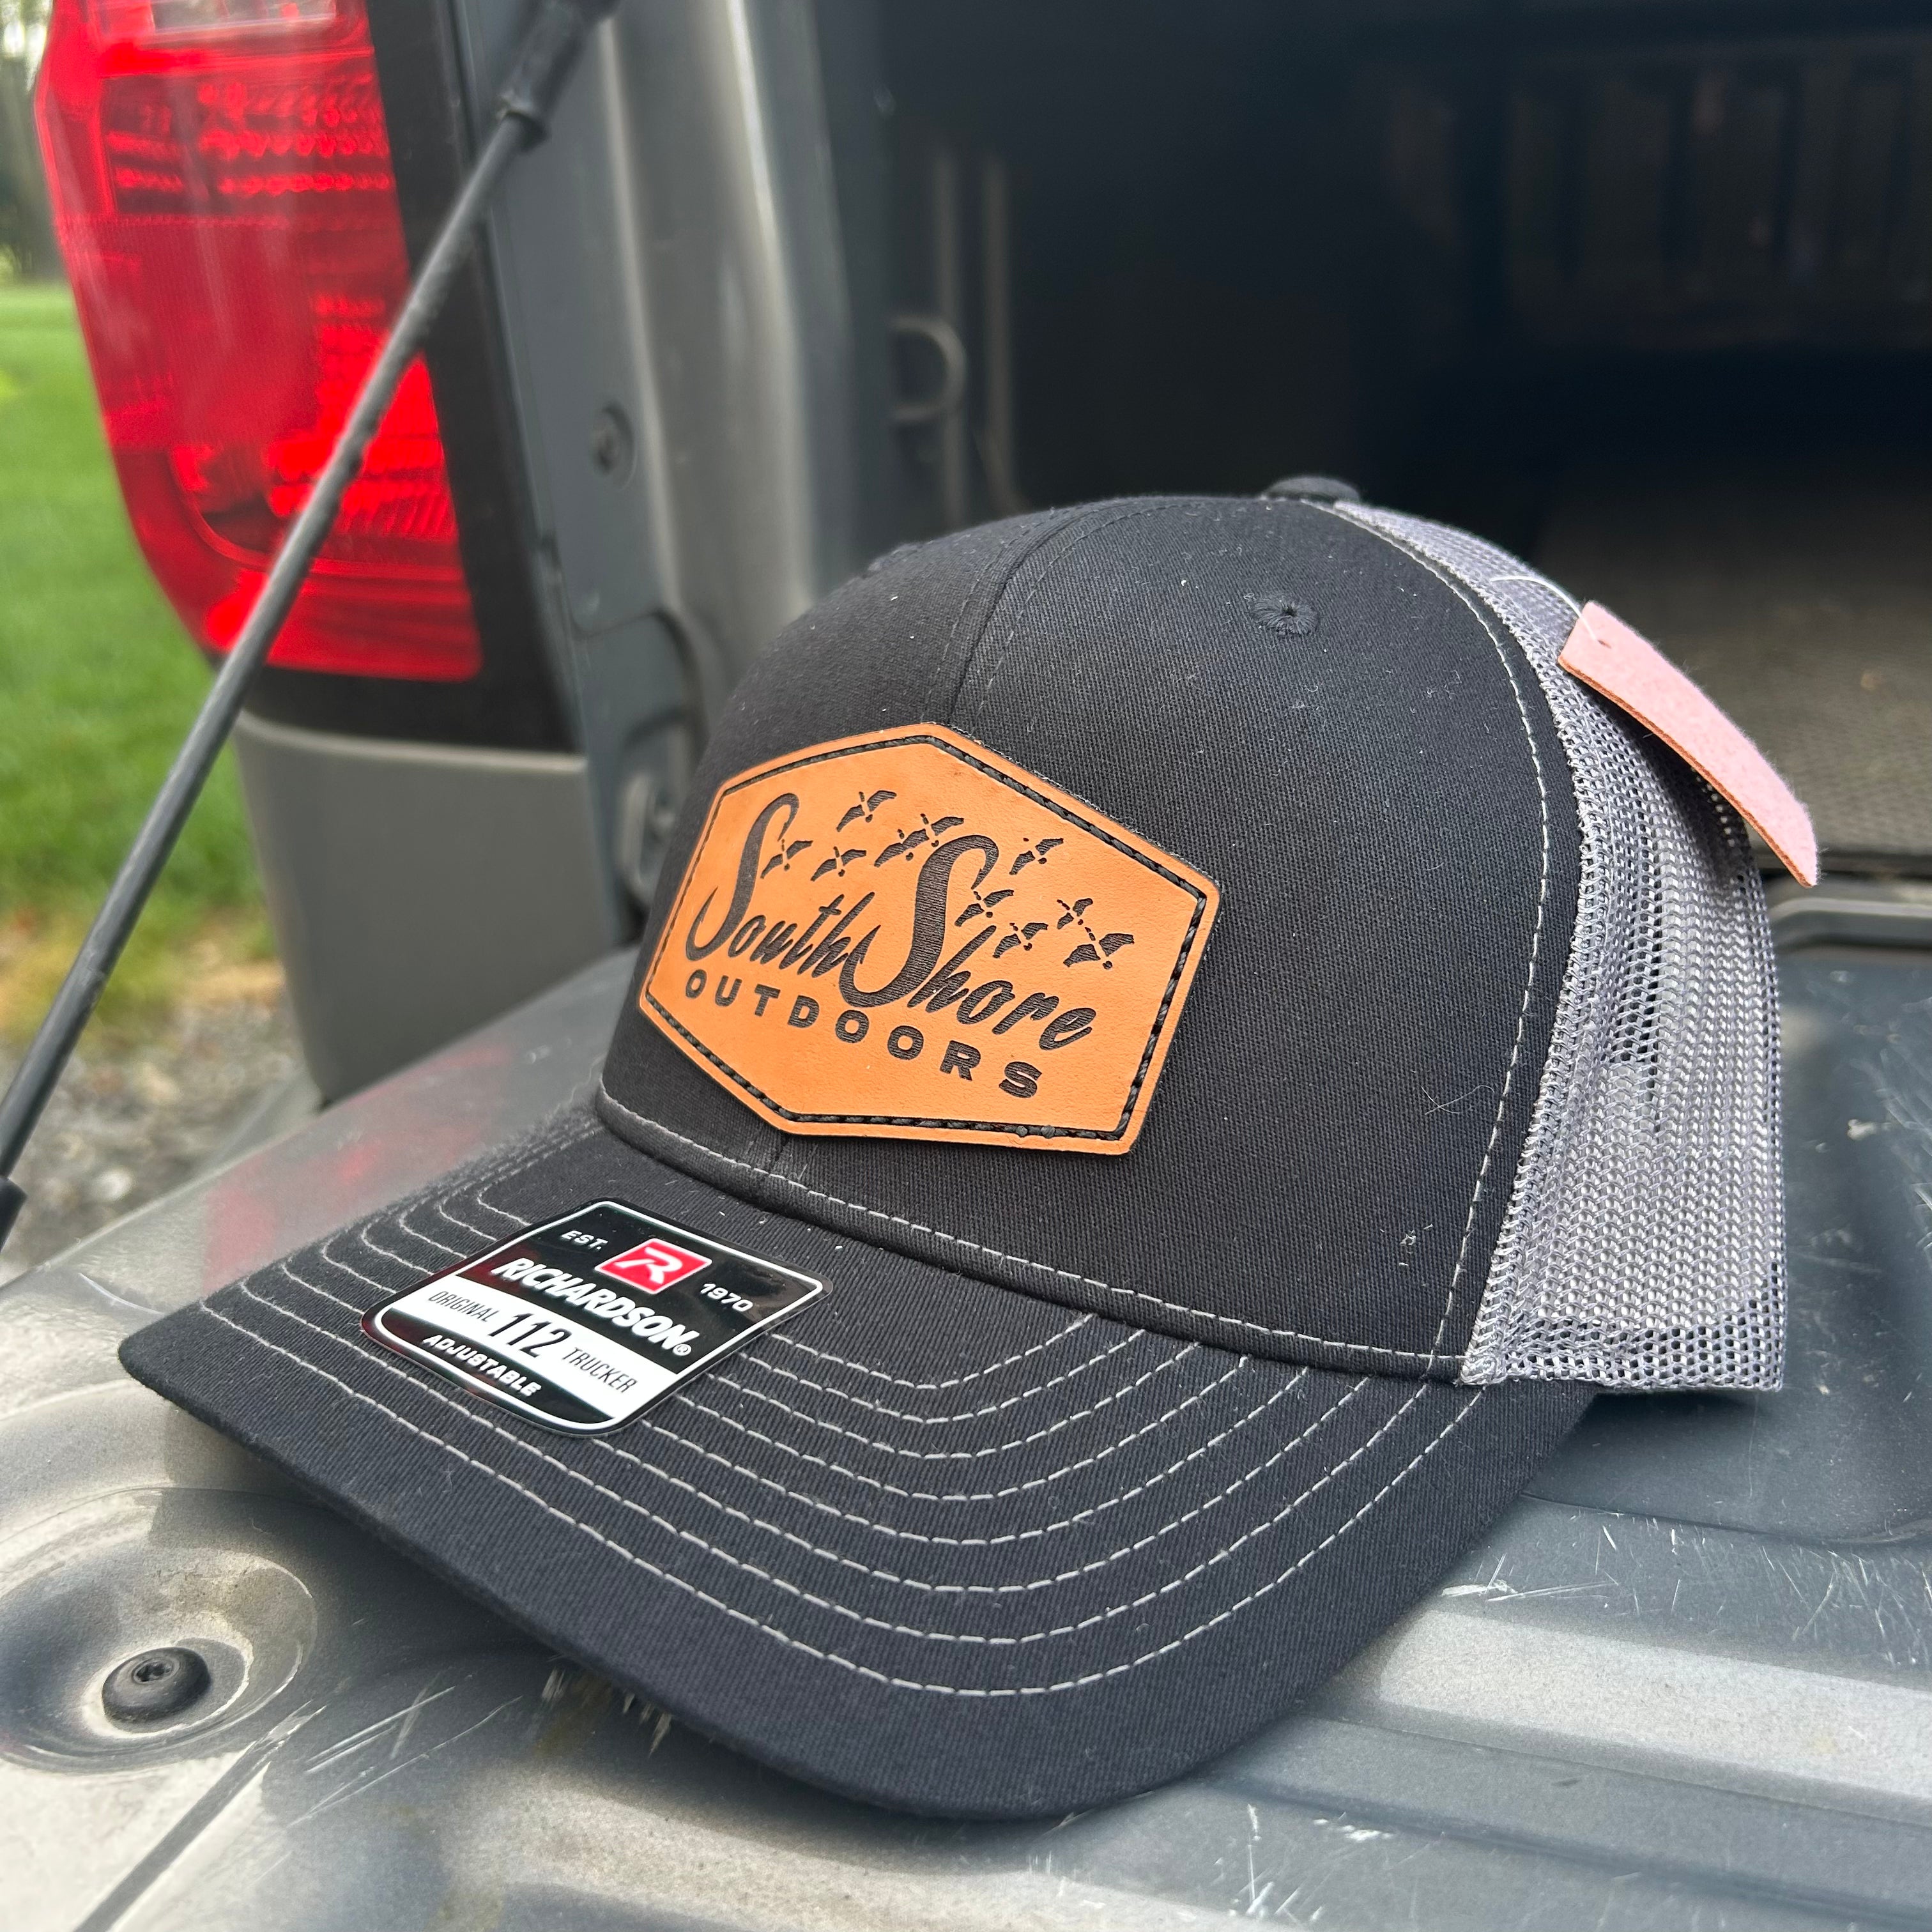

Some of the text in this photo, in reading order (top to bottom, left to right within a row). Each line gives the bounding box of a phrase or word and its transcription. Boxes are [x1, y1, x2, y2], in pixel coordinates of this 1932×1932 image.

[686, 792, 1096, 1051] South Shore
[684, 969, 1043, 1099] OUTDOORS
[560, 1229, 608, 1251] EST.
[700, 1282, 754, 1314] 1970
[423, 1333, 542, 1397] ADJUSTABLE
[428, 1291, 638, 1395] ORIGINAL 112 TRUCKER
